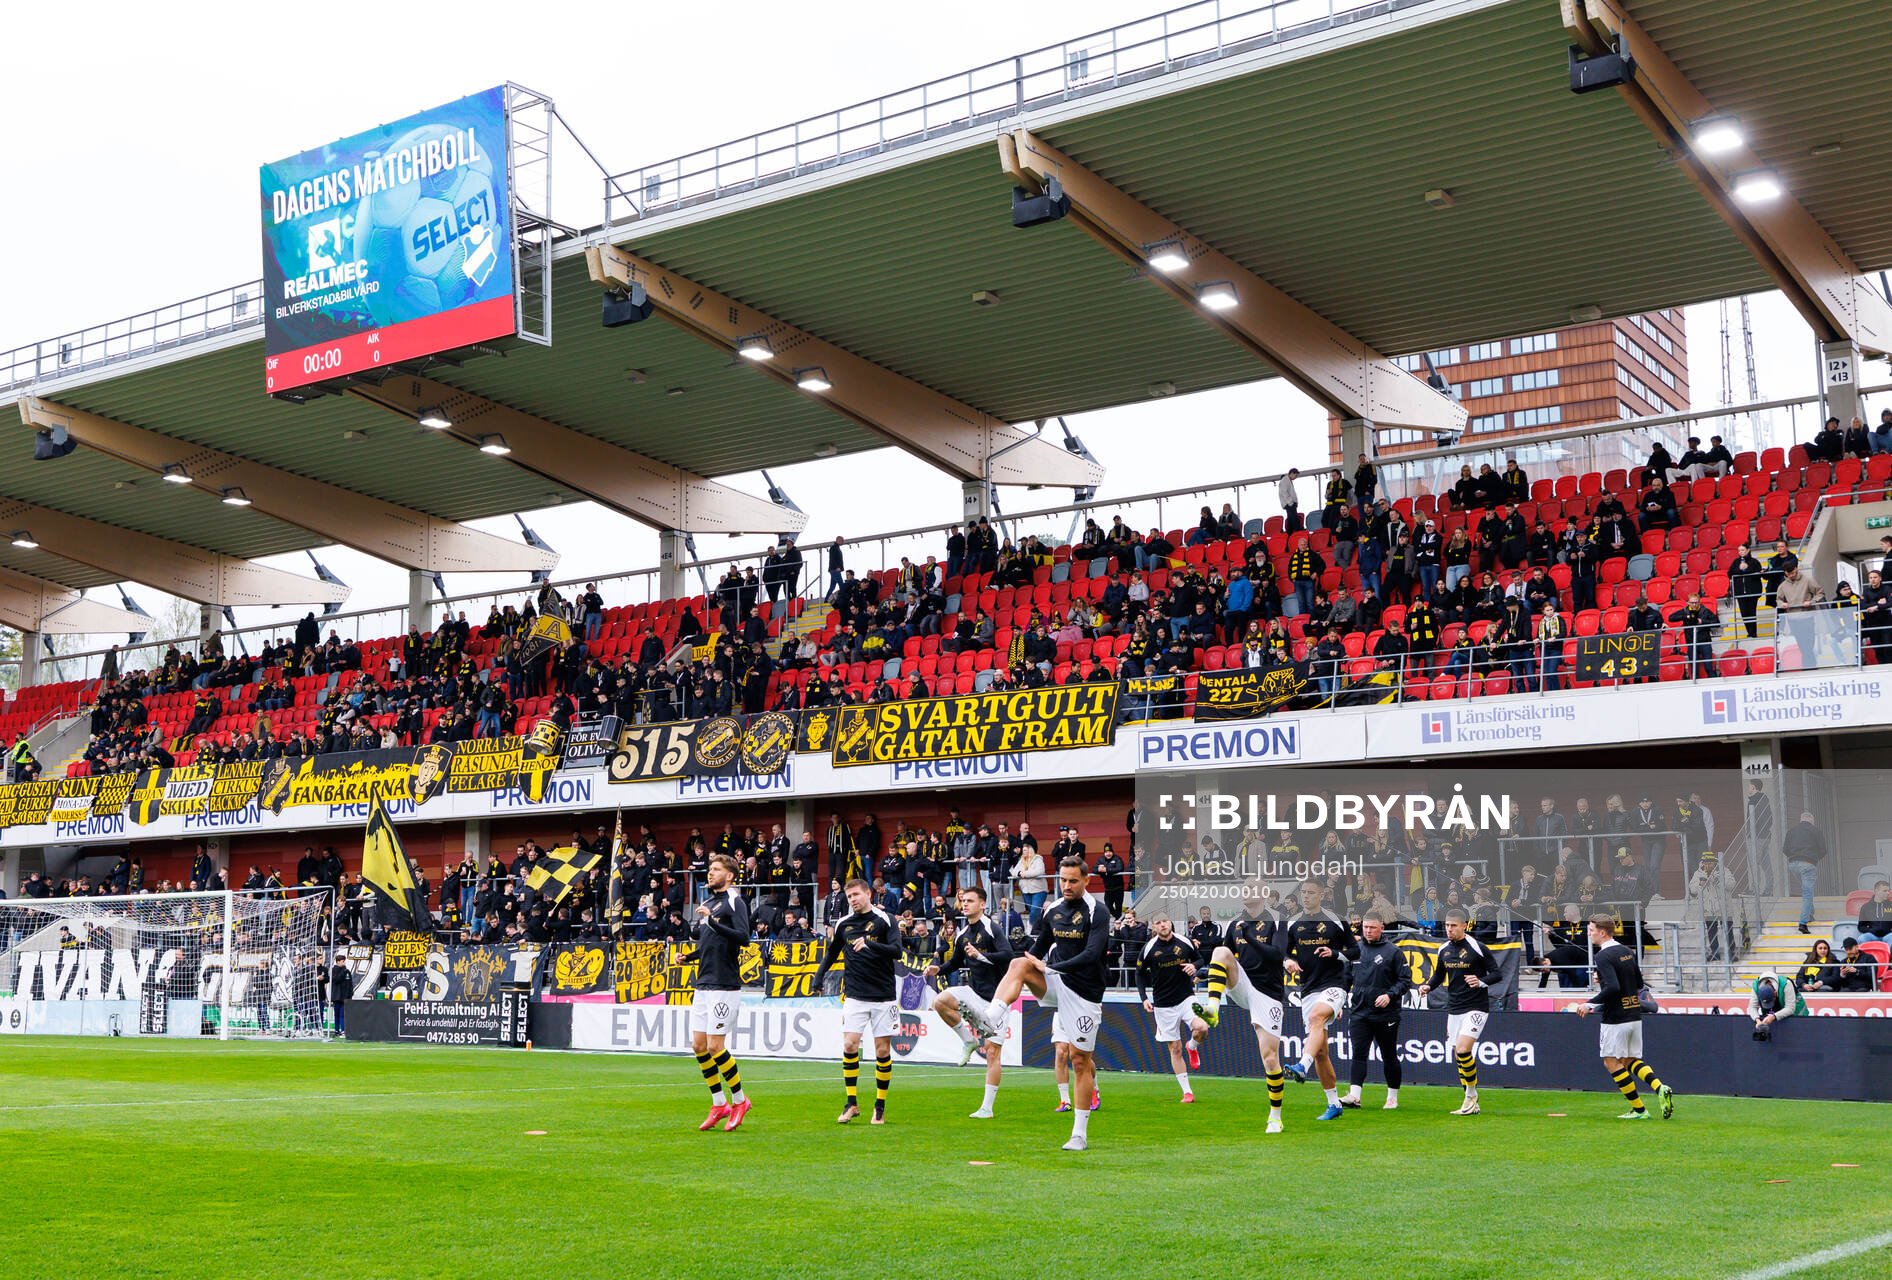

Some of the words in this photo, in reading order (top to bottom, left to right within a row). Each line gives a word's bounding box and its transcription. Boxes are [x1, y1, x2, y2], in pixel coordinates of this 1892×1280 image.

[273, 166, 351, 224] DAGENS
[353, 127, 481, 199] MATCHBOLL
[412, 189, 490, 262] SELECT
[284, 259, 368, 299] REALMEC
[367, 333, 380, 345] AIK
[303, 348, 342, 374] 00:00
[373, 350, 380, 363] 0
[1829, 361, 1840, 371] 12
[267, 376, 274, 389] 0
[1838, 372, 1849, 382] 13
[1600, 657, 1638, 677] 43
[1208, 686, 1244, 702] 227
[878, 685, 1114, 733] SVARTGULT
[1743, 702, 1842, 723] Kronoberg
[873, 725, 992, 760] GATAN
[998, 715, 1110, 750] FRAM
[1456, 724, 1542, 743] Kronoberg
[456, 738, 500, 755] NORRA
[611, 722, 697, 780] 515
[1142, 726, 1296, 764] PREMON
[169, 763, 217, 782] NILS
[217, 760, 266, 779] LENNART
[19, 780, 60, 798] GUSTAV
[59, 777, 102, 797] SUNE
[167, 781, 209, 798] MED
[213, 776, 262, 795] CIRKUS
[293, 778, 406, 803] FANBÄRARNA
[449, 773, 507, 791] PELARE
[133, 787, 166, 801] BOJAN
[493, 779, 592, 807] PRMON
[18, 796, 52, 811] GURRA
[160, 798, 208, 816] SKILLS
[329, 798, 415, 819] PREON
[56, 815, 125, 837] PREMON
[615, 974, 666, 1003] TIFO
[404, 1002, 430, 1015] PeHå
[500, 992, 513, 1042] SELECT
[516, 993, 529, 1042] SELECT
[404, 1017, 426, 1027] Service
[458, 1018, 468, 1029] på
[611, 1008, 813, 1052] EMILHUS
[467, 1033, 479, 1044] 90
